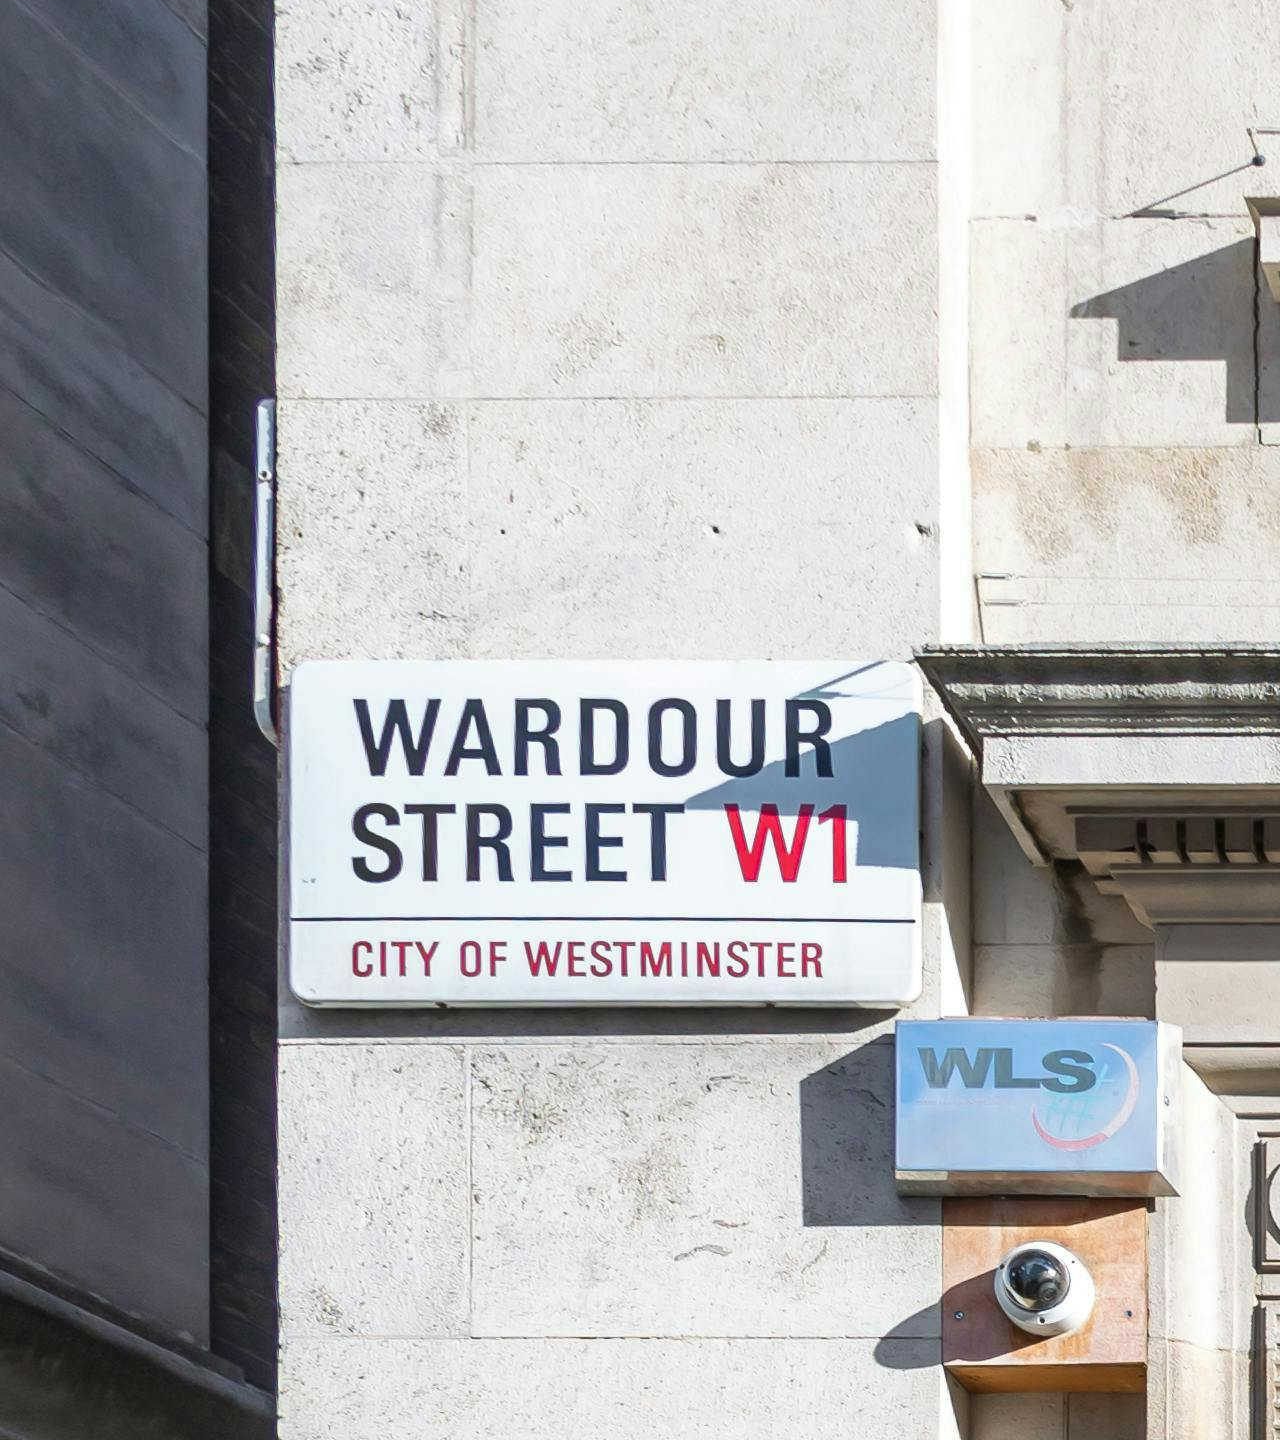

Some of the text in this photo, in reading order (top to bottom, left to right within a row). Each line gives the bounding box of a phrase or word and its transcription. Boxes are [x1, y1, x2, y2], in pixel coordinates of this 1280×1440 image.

[352, 697, 835, 779] WARDOUR
[351, 802, 848, 884] STREET W1
[351, 940, 824, 979] CITY OF WESTMINSTER
[917, 1046, 1097, 1094] WLS
